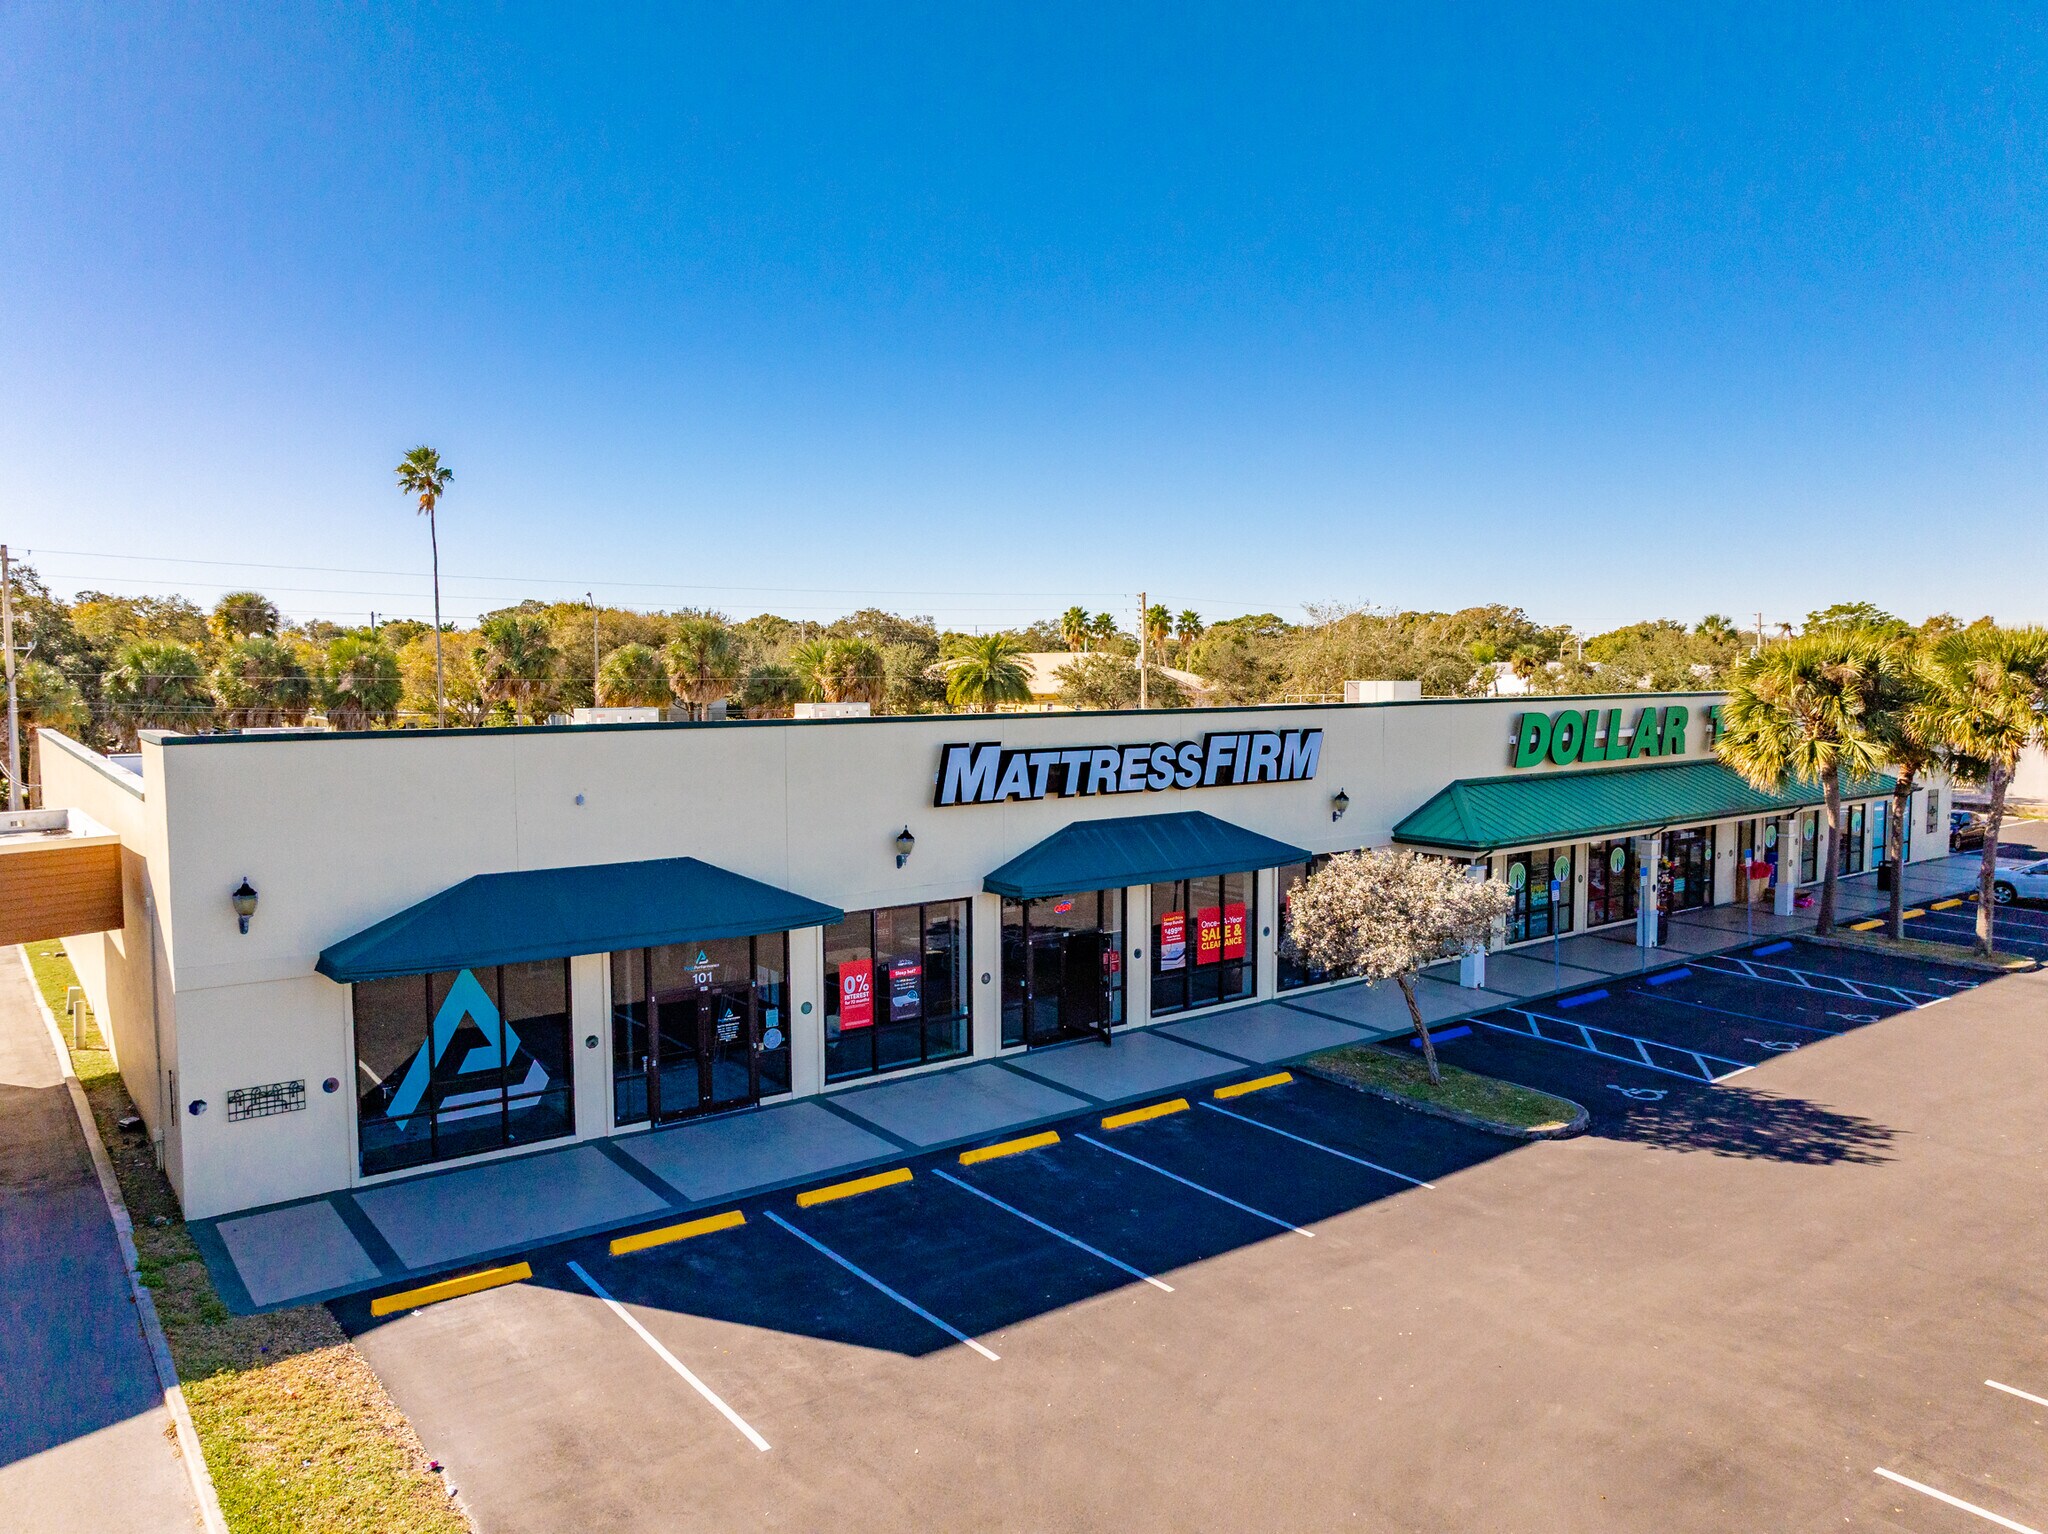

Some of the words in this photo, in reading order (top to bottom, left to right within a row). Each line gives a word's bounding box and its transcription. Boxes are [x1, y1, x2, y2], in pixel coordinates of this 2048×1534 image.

[1515, 705, 1689, 768] DOLLAR
[1201, 925, 1232, 942] SALE
[1233, 923, 1242, 937] &
[692, 971, 713, 984] 101
[844, 973, 870, 995] 0%
[844, 991, 870, 1001] INTEREST
